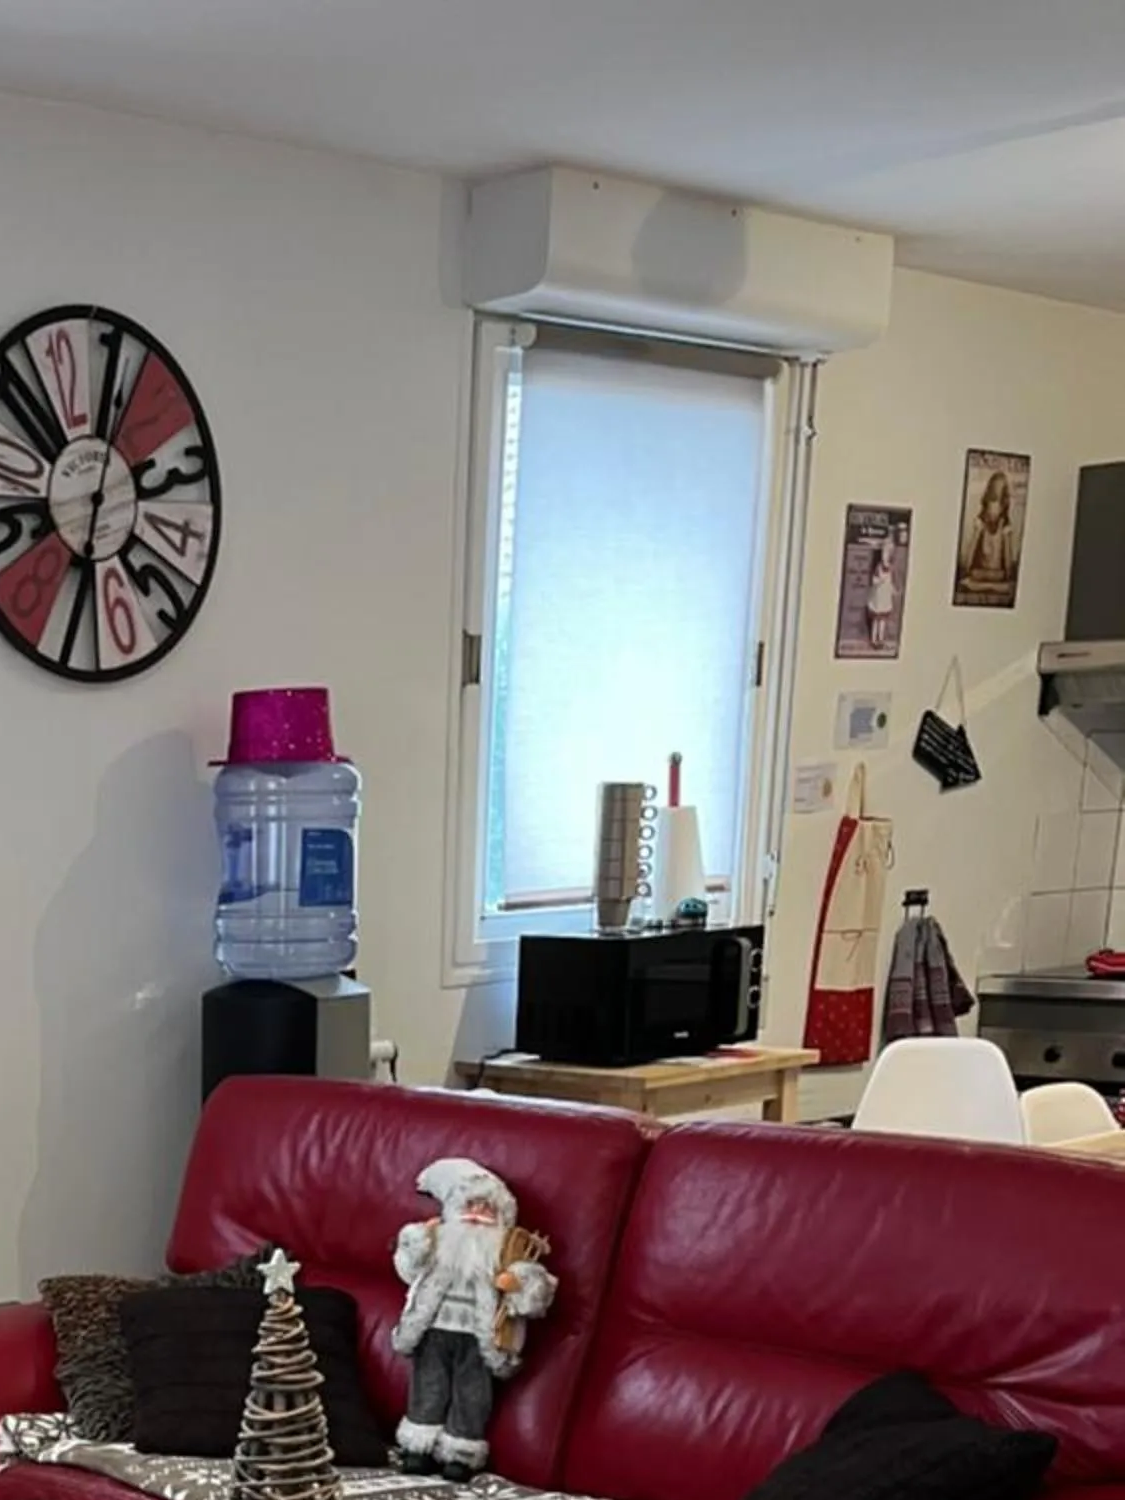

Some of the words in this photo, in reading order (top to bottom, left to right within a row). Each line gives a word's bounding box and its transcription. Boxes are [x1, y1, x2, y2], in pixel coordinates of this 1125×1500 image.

[45, 328, 88, 430] 12
[99, 328, 124, 438] 1
[137, 445, 208, 498] 3
[143, 510, 205, 557] 4
[10, 545, 63, 619] 8
[101, 567, 136, 655] 6
[118, 535, 189, 634] 5
